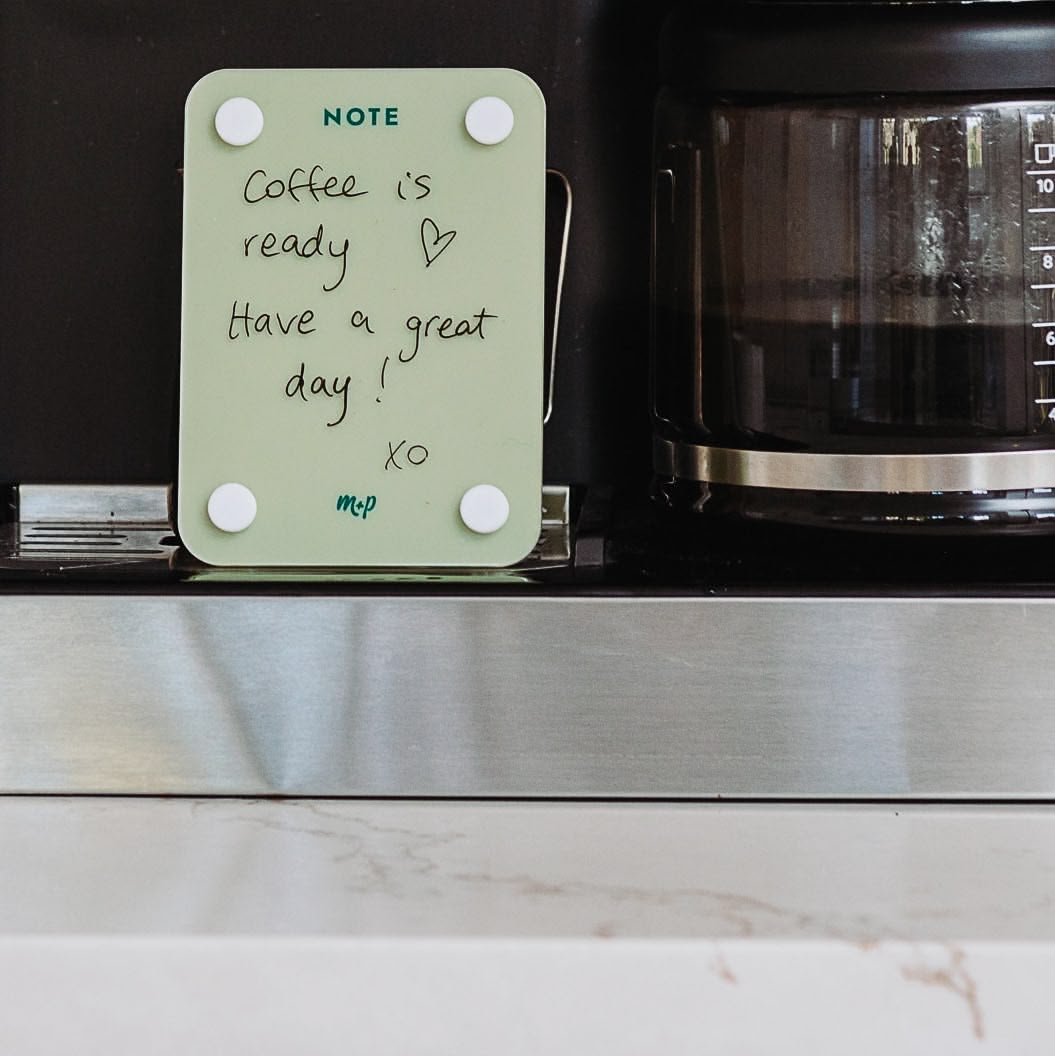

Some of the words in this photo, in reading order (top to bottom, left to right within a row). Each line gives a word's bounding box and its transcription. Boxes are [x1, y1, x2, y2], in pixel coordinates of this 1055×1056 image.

[323, 107, 399, 127] NOTE
[244, 165, 369, 204] Coffee
[397, 172, 431, 201] is
[1036, 178, 1054, 193] 10
[244, 224, 350, 293] ready
[1043, 254, 1054, 269] 8
[228, 300, 317, 340] Have
[351, 310, 375, 334] a
[399, 307, 499, 363] great
[285, 362, 352, 428] day
